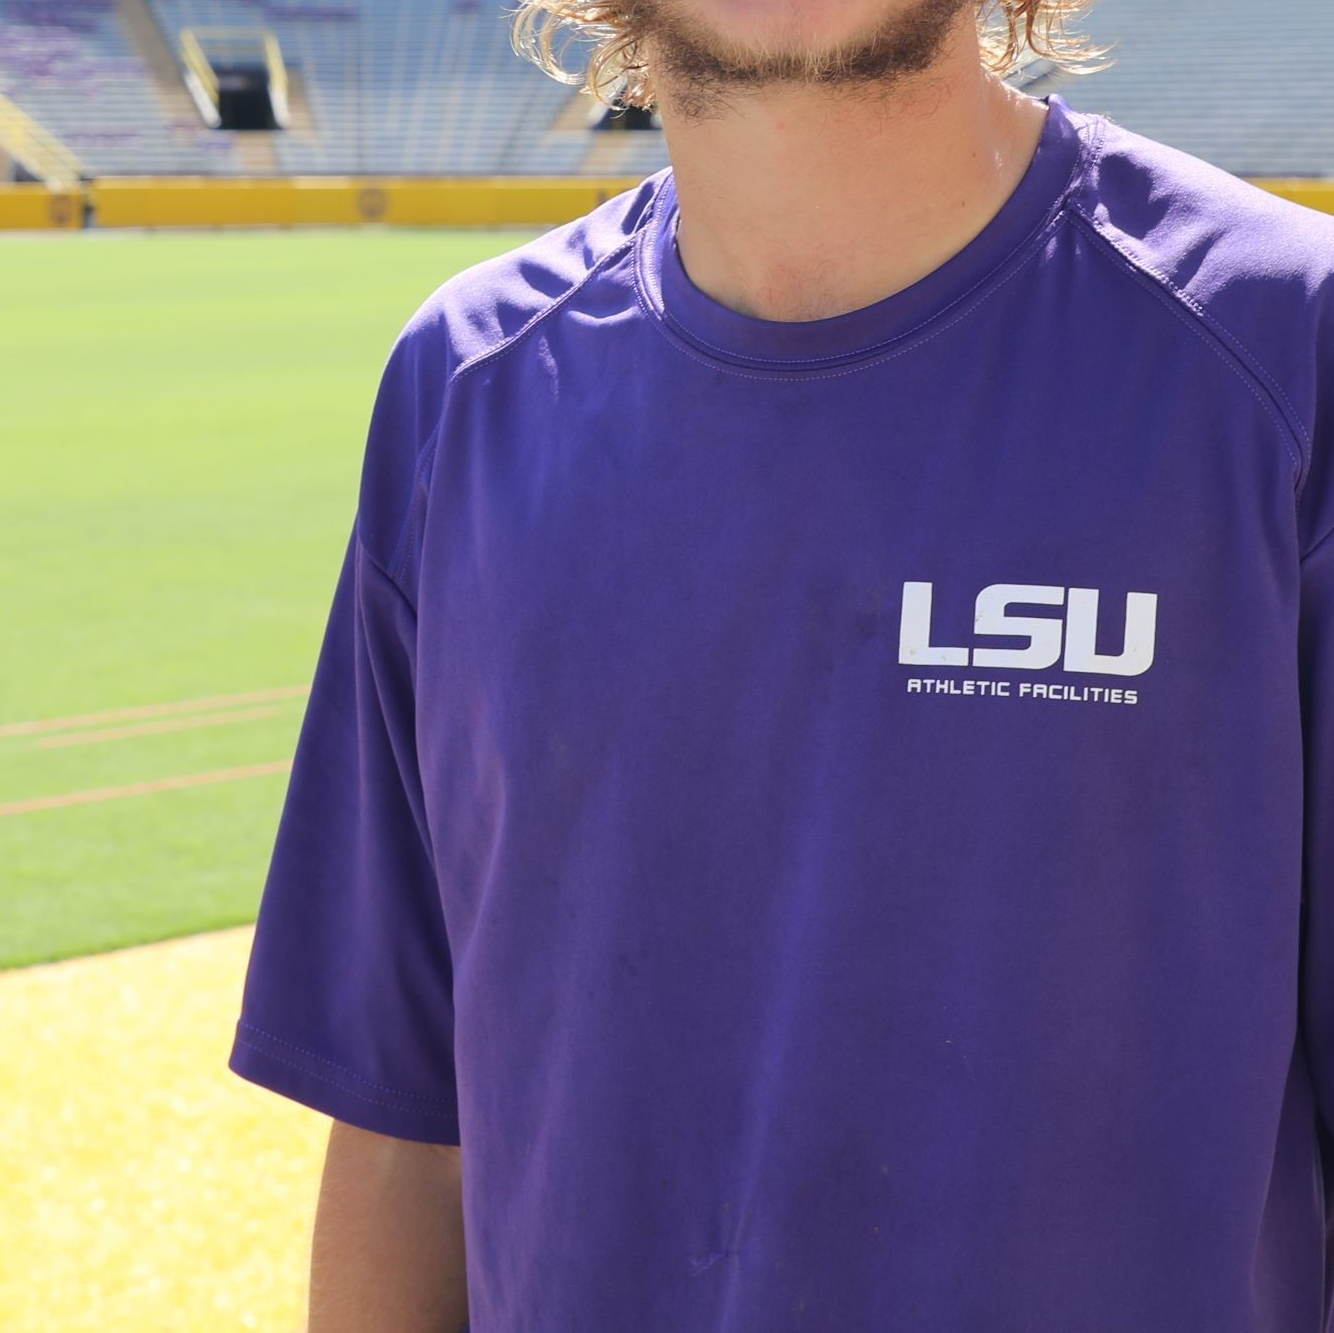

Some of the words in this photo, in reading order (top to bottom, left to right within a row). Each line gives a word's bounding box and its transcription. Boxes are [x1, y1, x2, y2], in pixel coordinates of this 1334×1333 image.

[898, 581, 1158, 677] LSU
[907, 678, 1011, 697] ATHLETIC
[1018, 683, 1139, 705] FACILITIES
